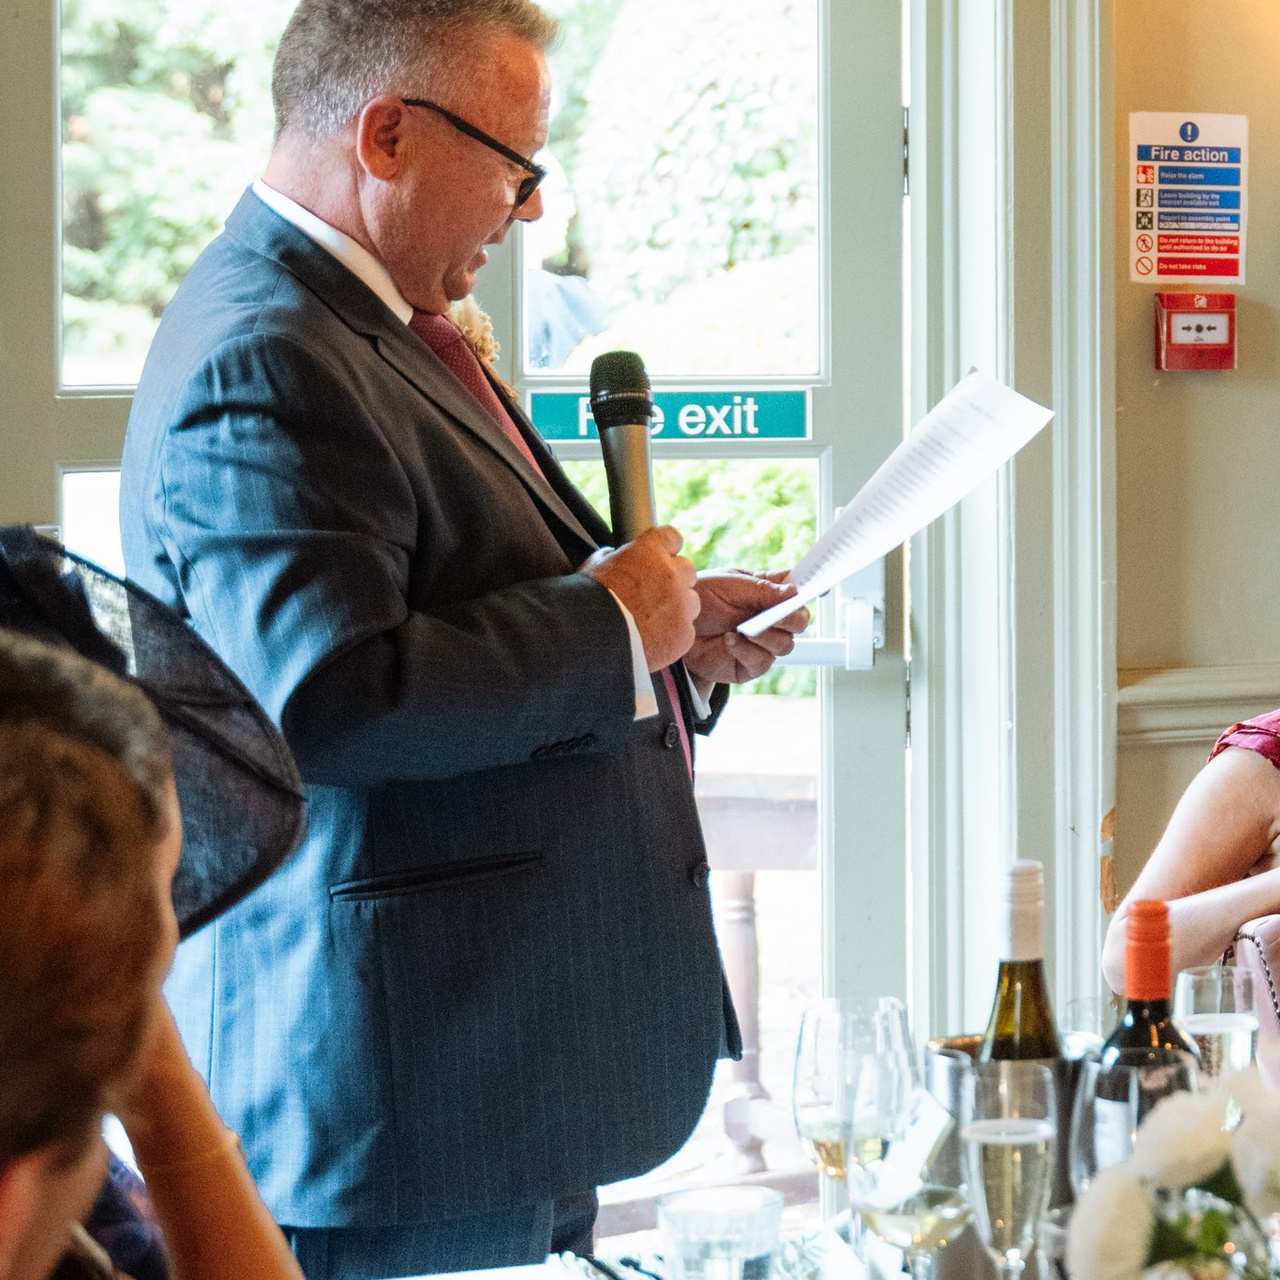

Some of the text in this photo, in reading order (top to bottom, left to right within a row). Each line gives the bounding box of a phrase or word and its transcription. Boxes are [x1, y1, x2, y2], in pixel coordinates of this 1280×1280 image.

[1151, 146, 1229, 162] Fire action
[1179, 192, 1201, 200] building
[1160, 214, 1180, 222] Report
[1215, 238, 1238, 246] building
[578, 395, 759, 436] Fe exit
